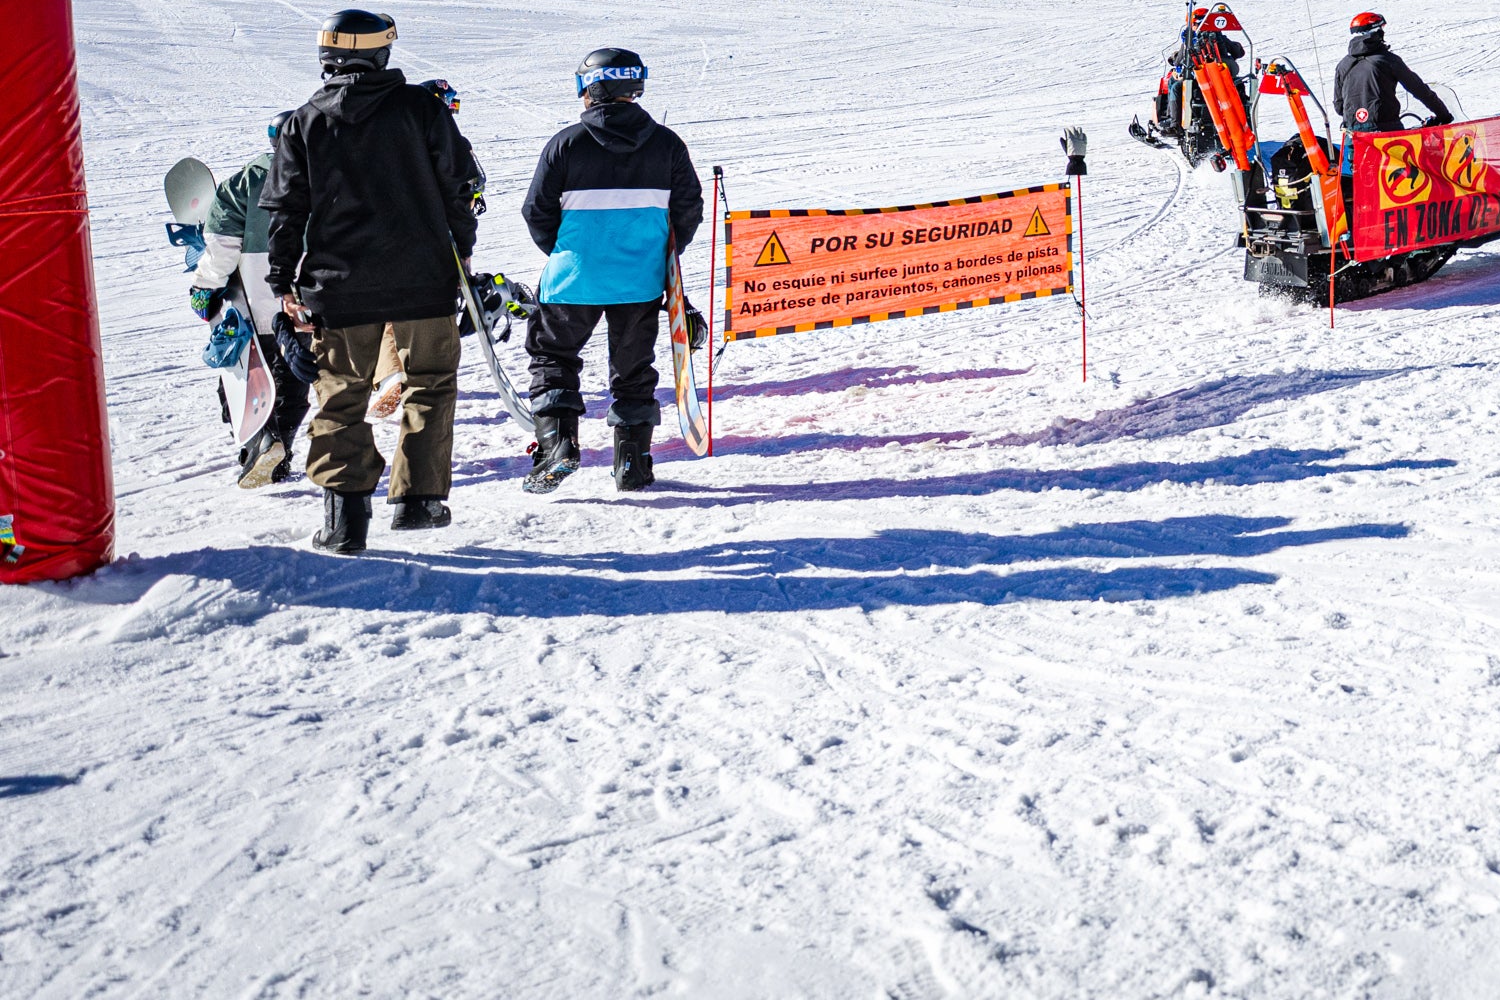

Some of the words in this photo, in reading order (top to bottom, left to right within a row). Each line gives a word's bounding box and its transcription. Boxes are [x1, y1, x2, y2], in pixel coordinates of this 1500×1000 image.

[583, 66, 642, 85] OAKLEY
[810, 235, 858, 254] POR
[865, 231, 895, 249] SU
[901, 218, 1013, 246] SEGURIDAD
[1384, 206, 1409, 249] EN
[1415, 198, 1463, 243] ZONA
[1468, 193, 1489, 231] DE
[740, 295, 816, 317] Apártese
[821, 292, 841, 306] de
[846, 281, 938, 305] paravientos,
[942, 271, 1001, 289] cañones
[1005, 270, 1013, 283] y
[1016, 264, 1063, 282] pilonas
[744, 280, 767, 293] No
[772, 273, 826, 291] esquíe
[831, 271, 845, 285] ni
[850, 267, 898, 282] surfee
[902, 261, 939, 279] junto
[944, 260, 952, 271] a
[957, 254, 1003, 269] bordes
[1007, 250, 1023, 262] de
[1027, 246, 1059, 262] pista
